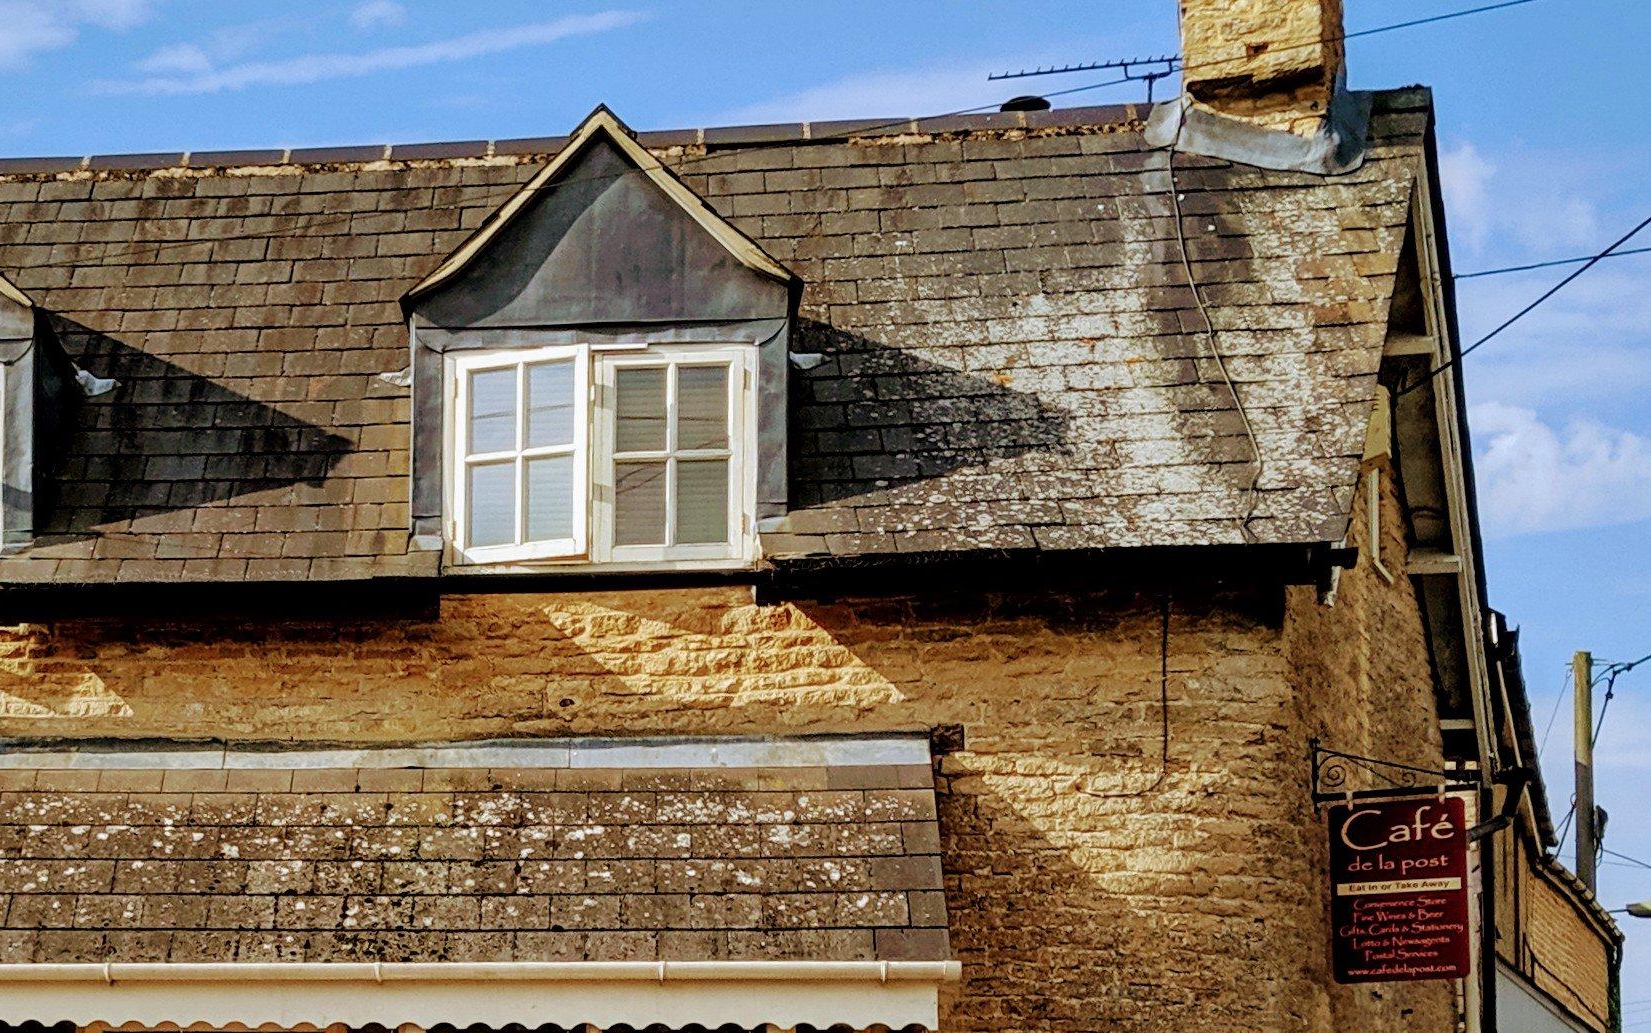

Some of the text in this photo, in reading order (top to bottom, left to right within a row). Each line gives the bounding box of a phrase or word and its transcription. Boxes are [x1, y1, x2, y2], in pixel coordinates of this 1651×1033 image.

[1341, 805, 1454, 850] Café
[1348, 854, 1448, 875] de la post
[1421, 880, 1451, 889] Away
